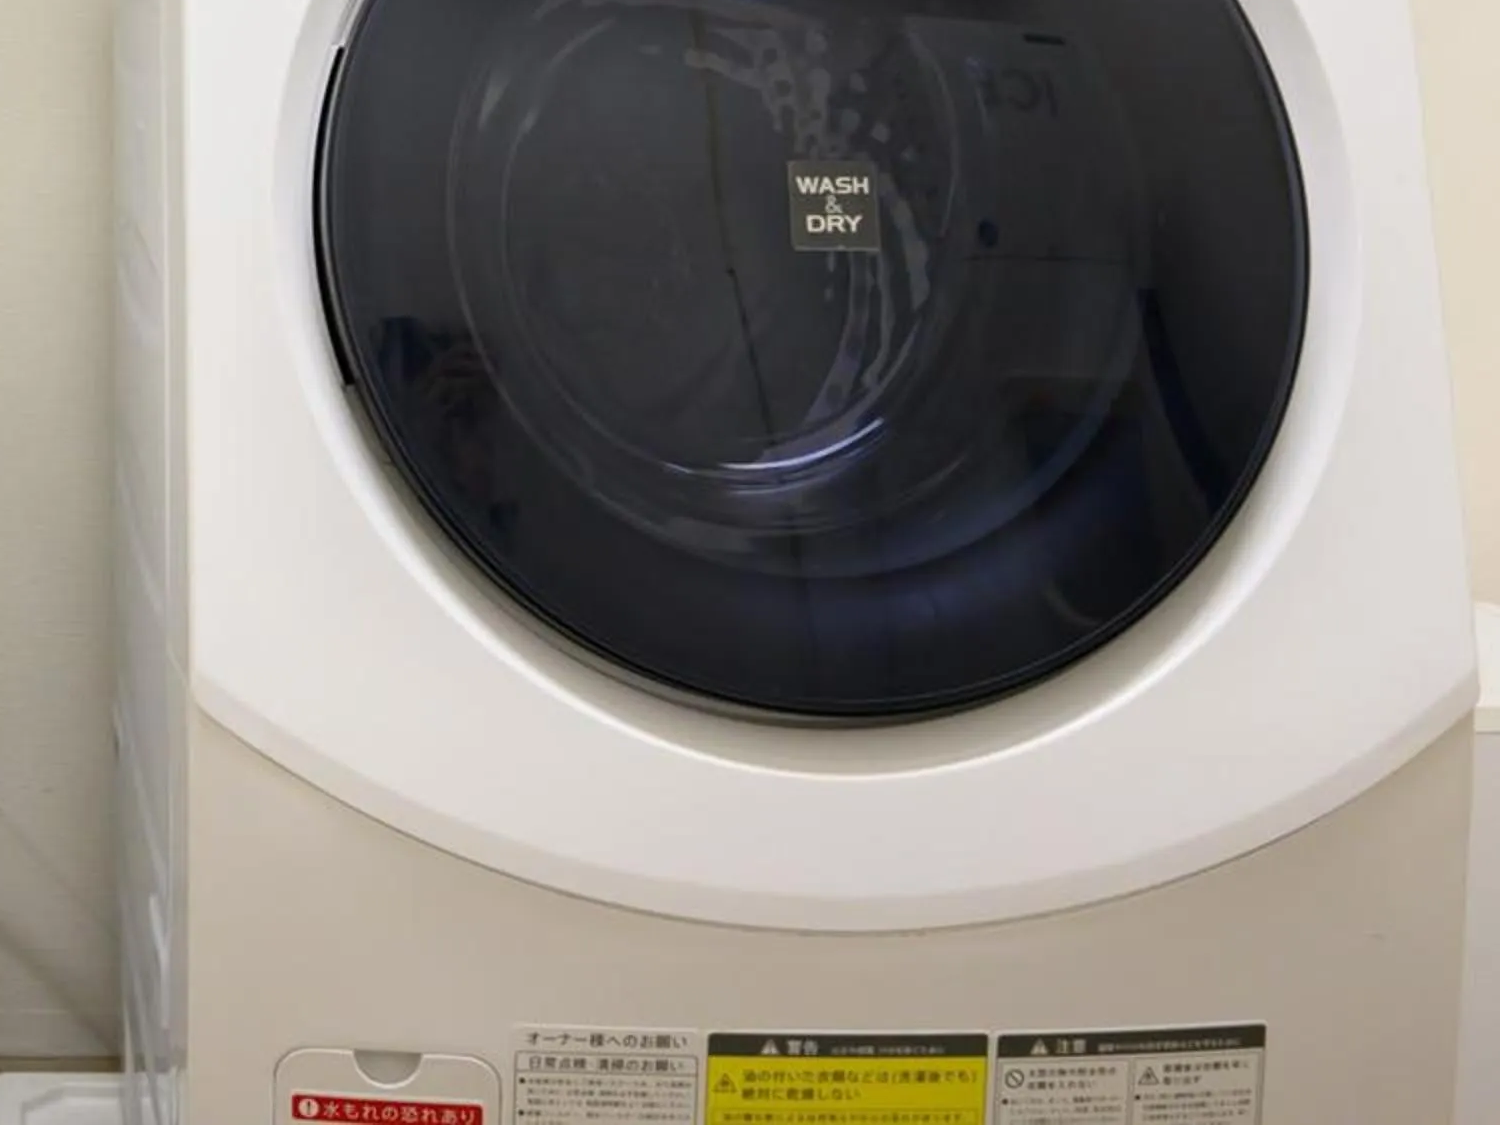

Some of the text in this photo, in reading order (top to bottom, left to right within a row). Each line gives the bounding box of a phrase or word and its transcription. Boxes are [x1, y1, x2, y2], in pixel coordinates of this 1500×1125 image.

[796, 176, 869, 194] WASH
[825, 195, 842, 213] &
[806, 215, 862, 233] DRY
[525, 1032, 687, 1050] オーナー様へのお願い
[786, 1040, 819, 1056] 警告
[1055, 1039, 1087, 1055] 注意
[323, 1103, 477, 1125] 水もれの恐れあり
